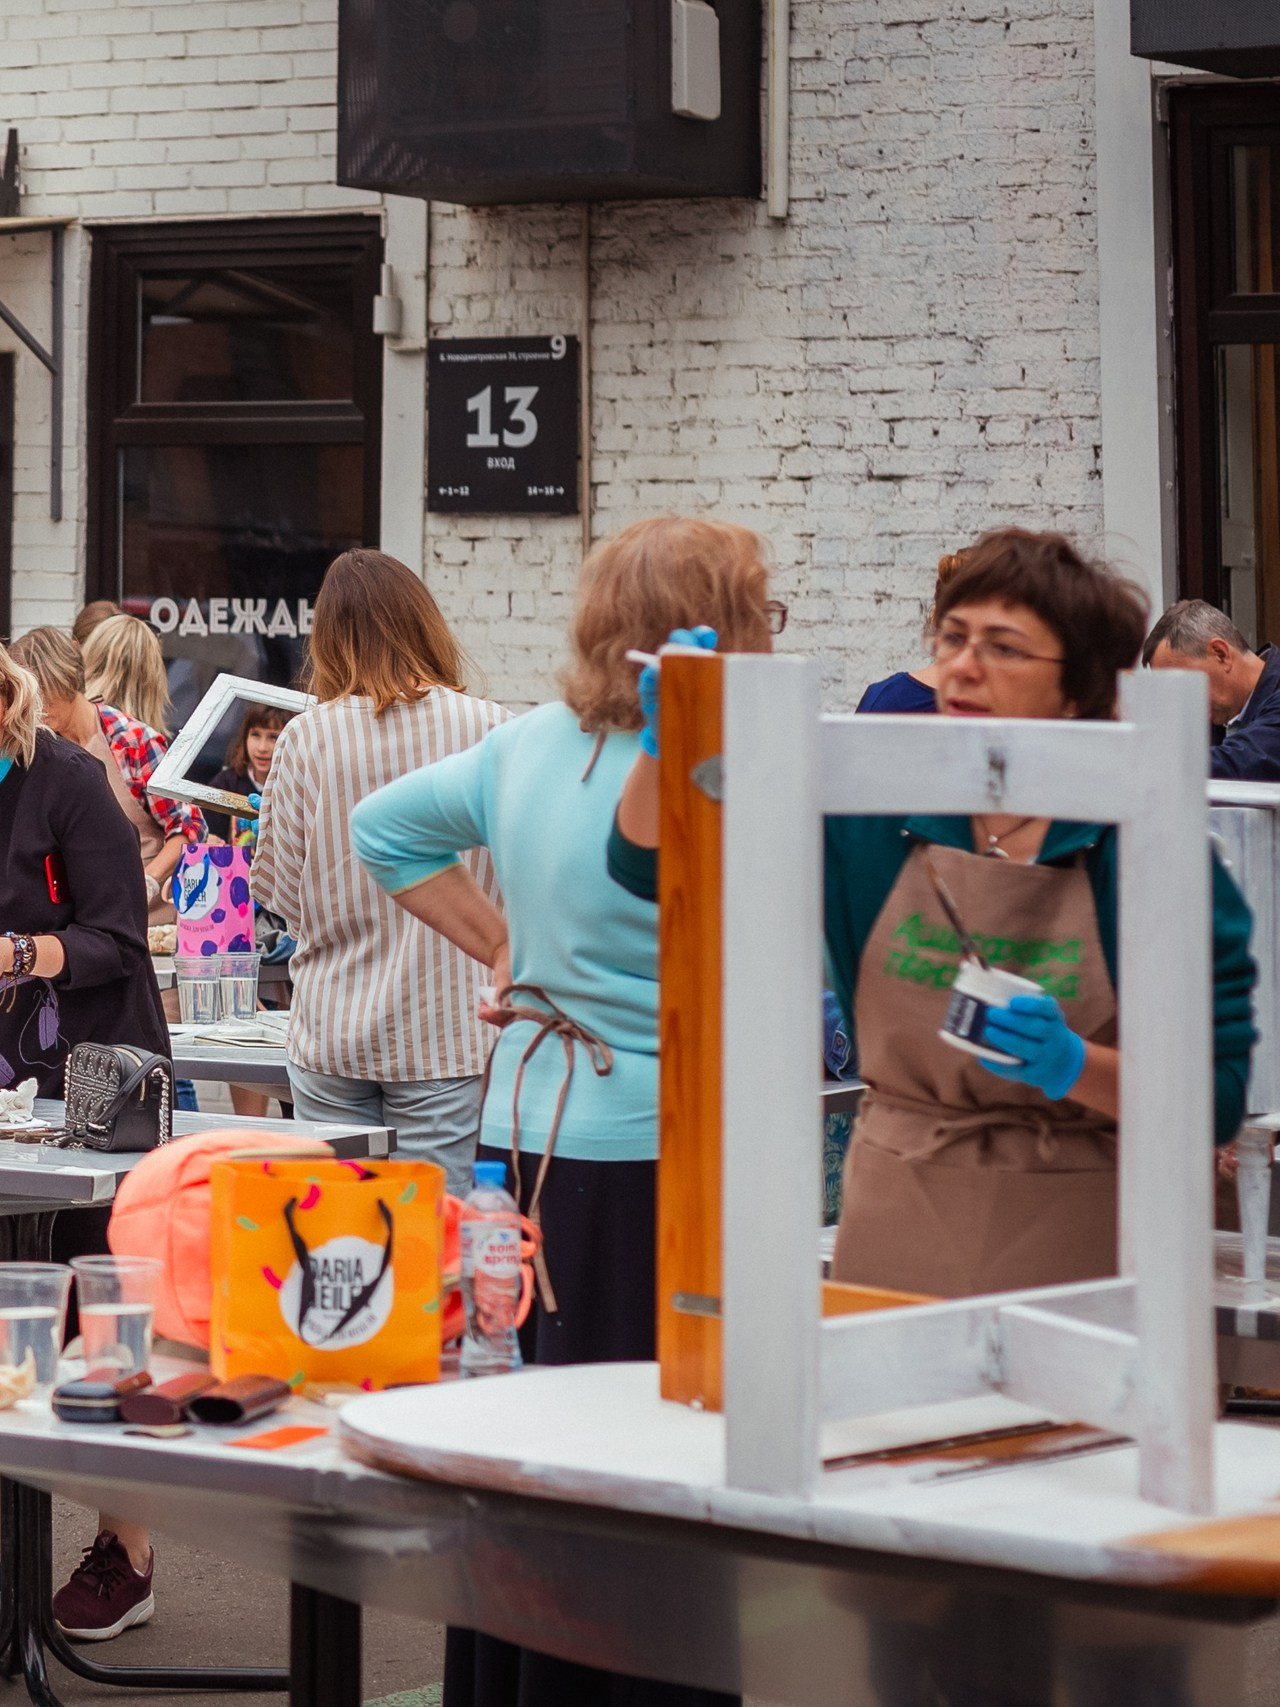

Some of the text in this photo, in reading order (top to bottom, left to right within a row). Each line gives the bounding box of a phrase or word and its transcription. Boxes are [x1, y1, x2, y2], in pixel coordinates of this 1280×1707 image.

[550, 335, 567, 360] 9
[466, 384, 539, 448] 13
[486, 456, 516, 470] ВХОД
[184, 878, 202, 889] DARI
